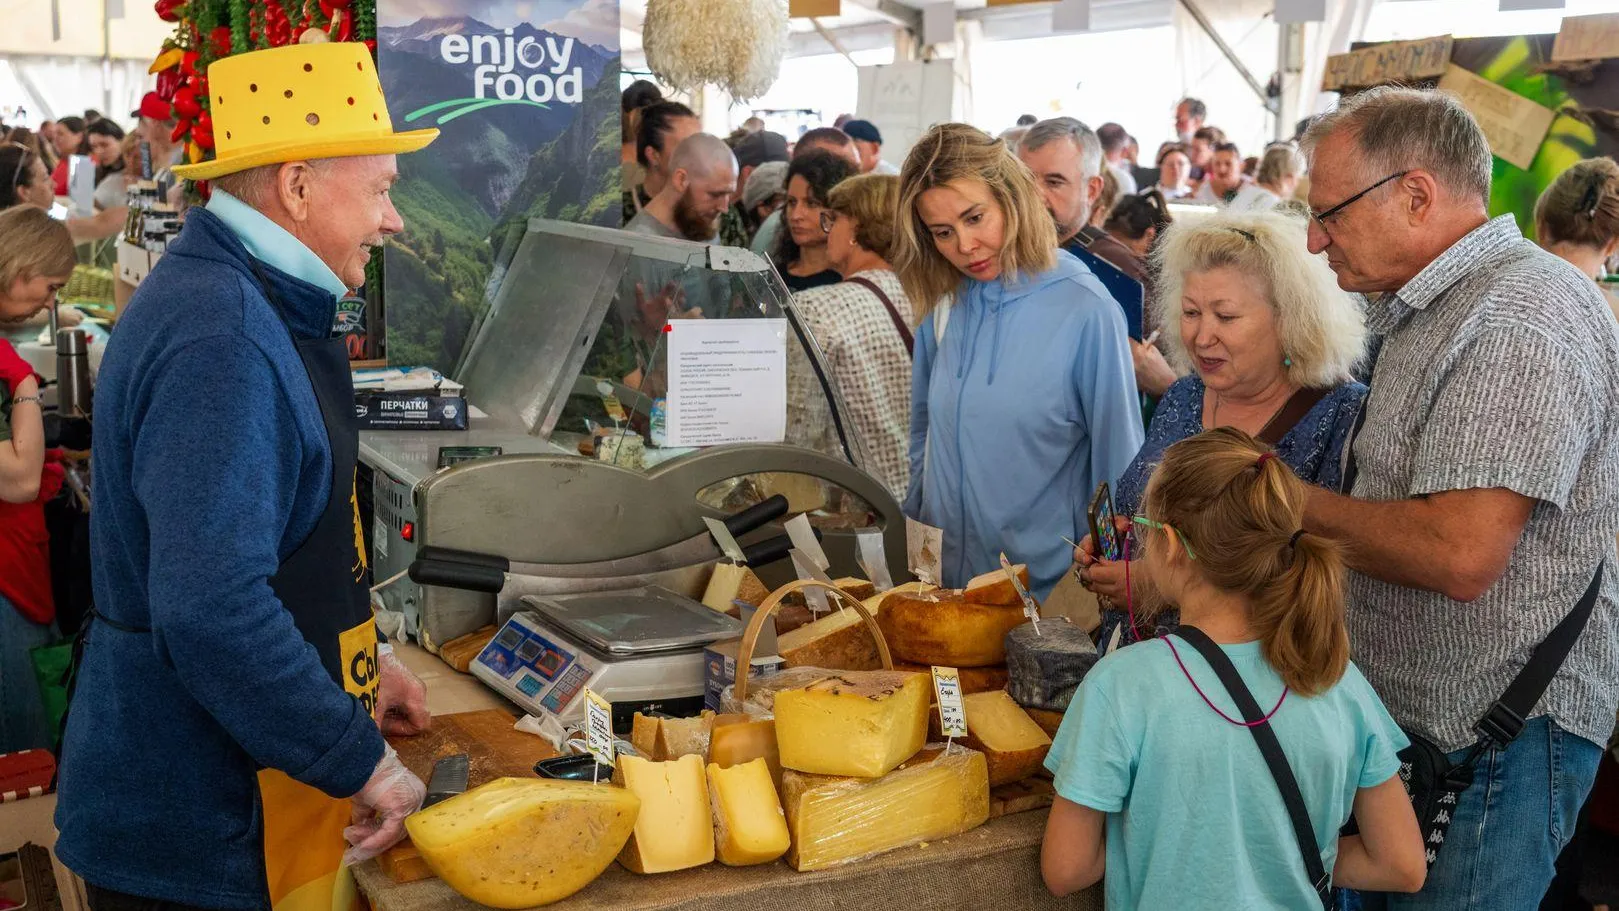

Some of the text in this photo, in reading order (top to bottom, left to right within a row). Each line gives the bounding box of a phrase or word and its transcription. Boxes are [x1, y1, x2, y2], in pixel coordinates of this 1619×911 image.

[440, 27, 574, 75] enjoy
[474, 64, 583, 103] food
[381, 400, 428, 410] ПЕРЧАТКИ
